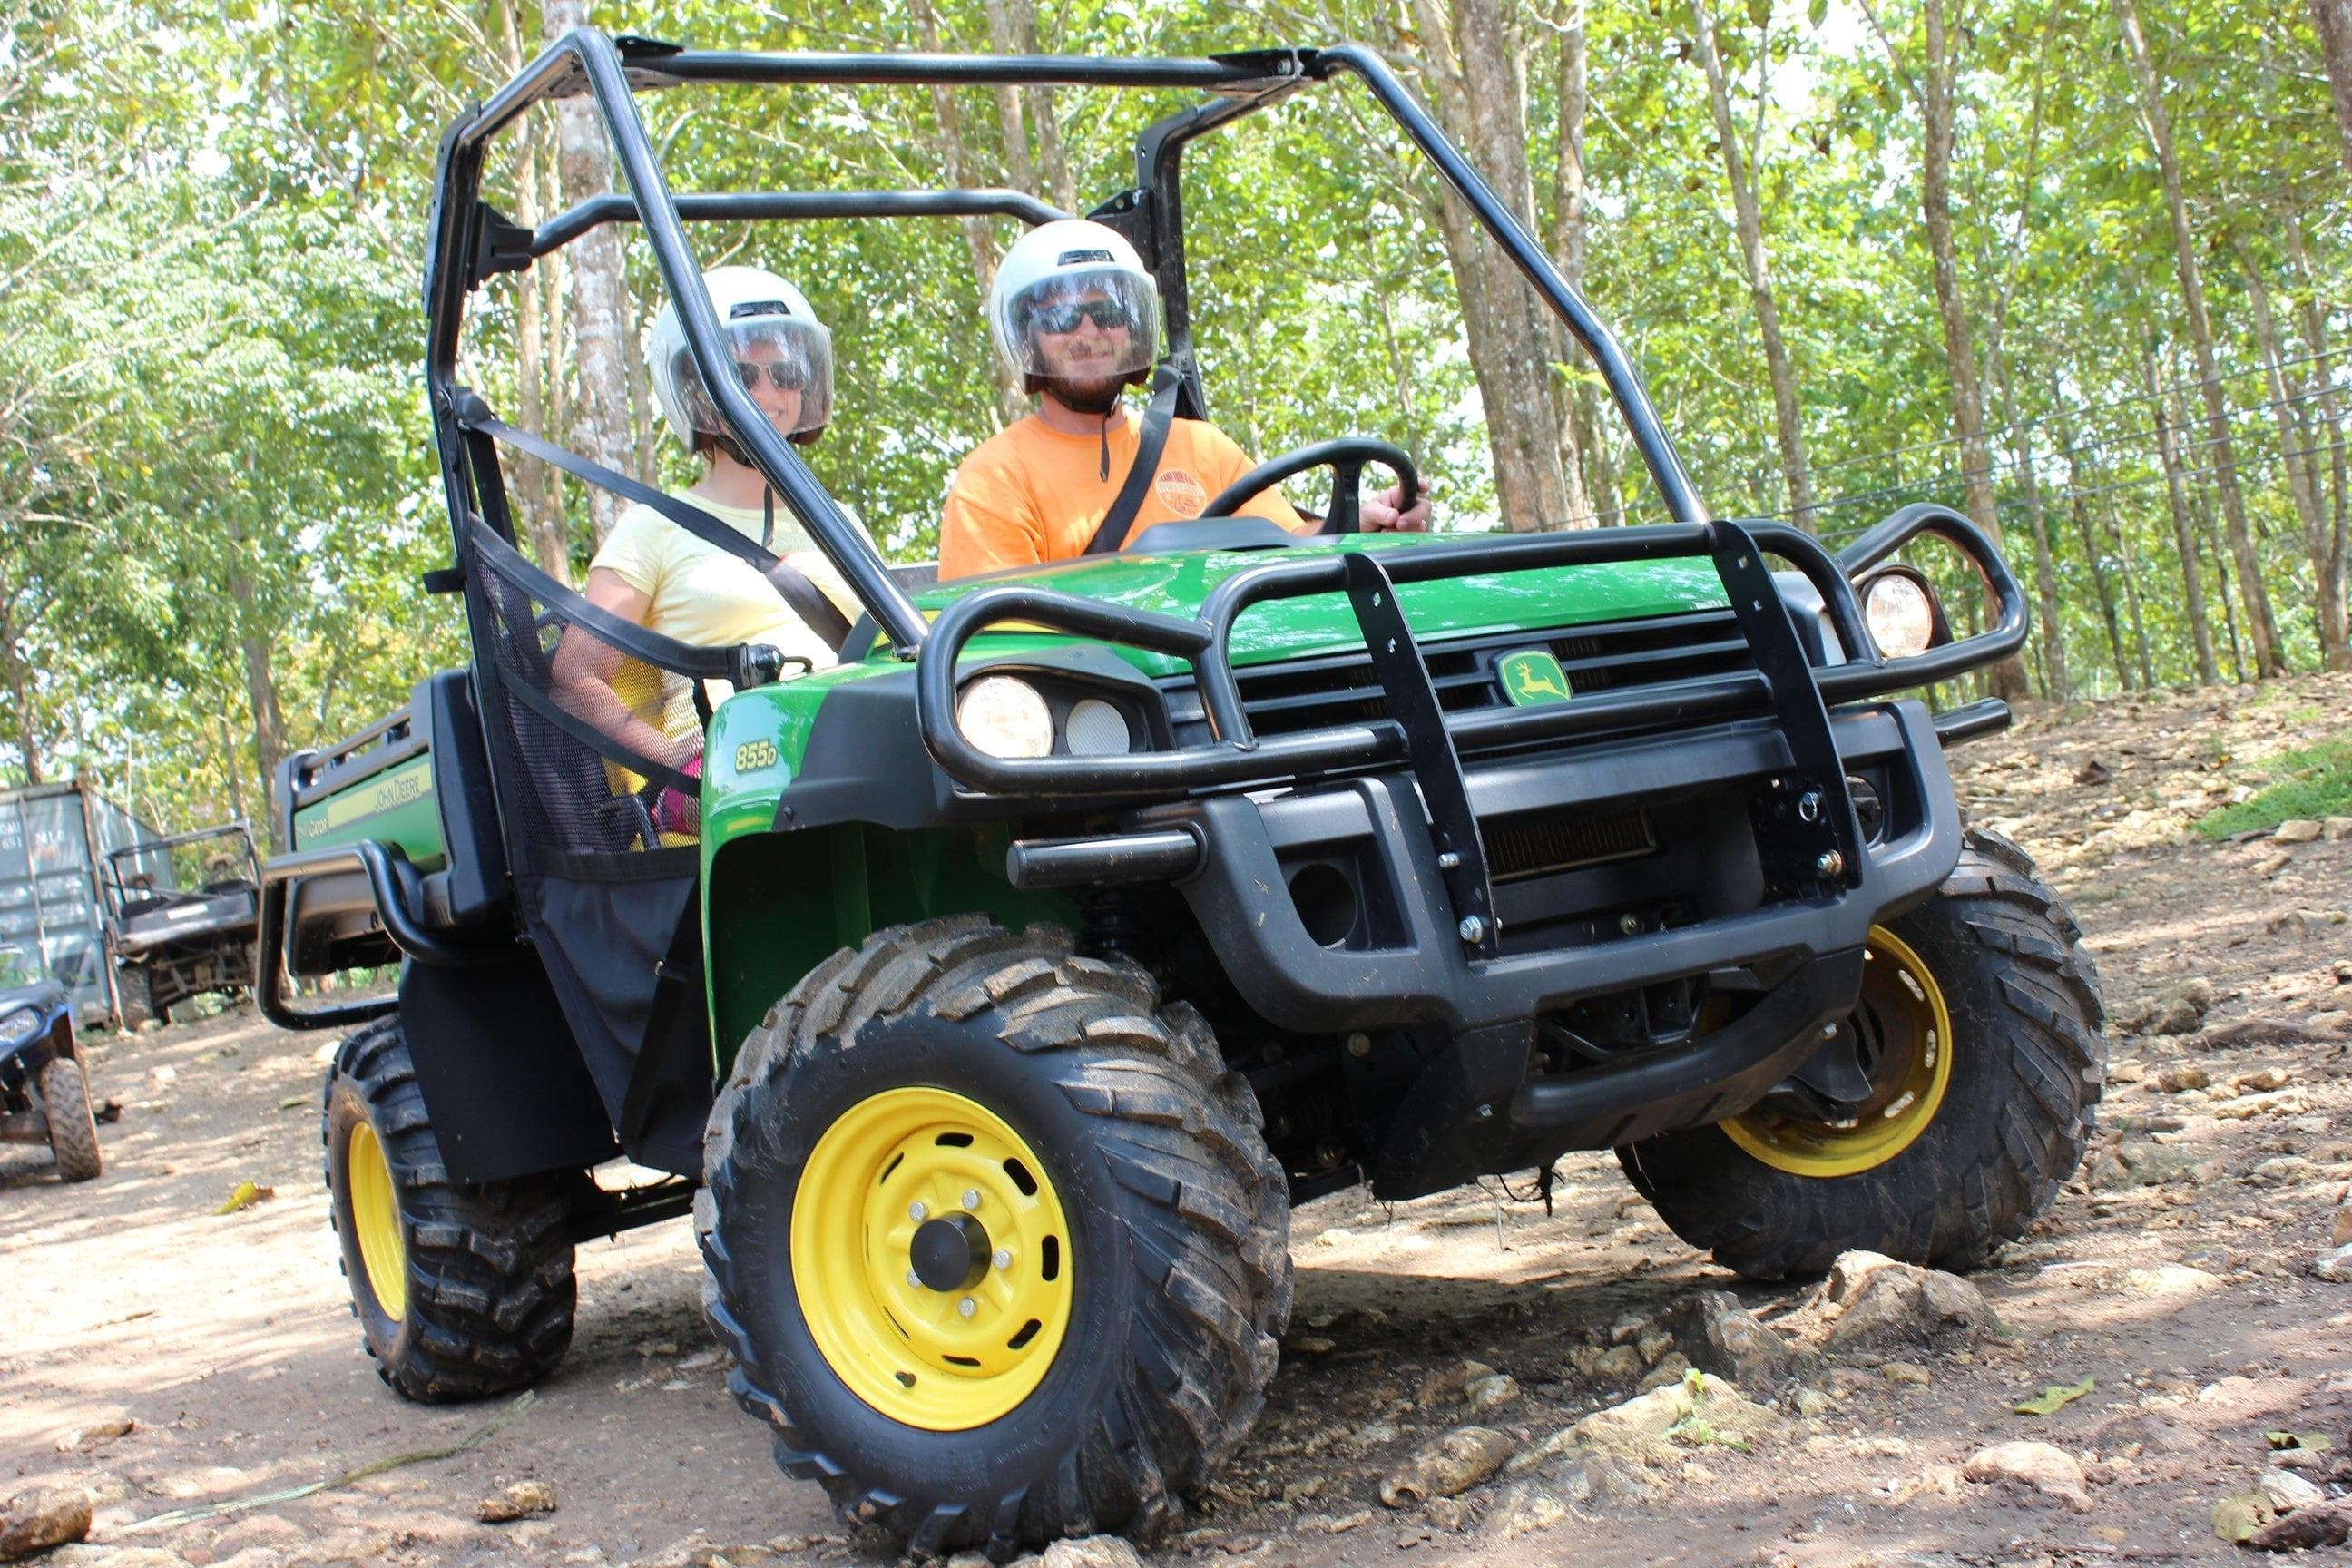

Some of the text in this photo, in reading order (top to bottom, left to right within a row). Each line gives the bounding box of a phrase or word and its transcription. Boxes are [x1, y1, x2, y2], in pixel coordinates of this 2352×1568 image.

[736, 740, 778, 773] 855D
[375, 775, 421, 809] JOHN DEERE
